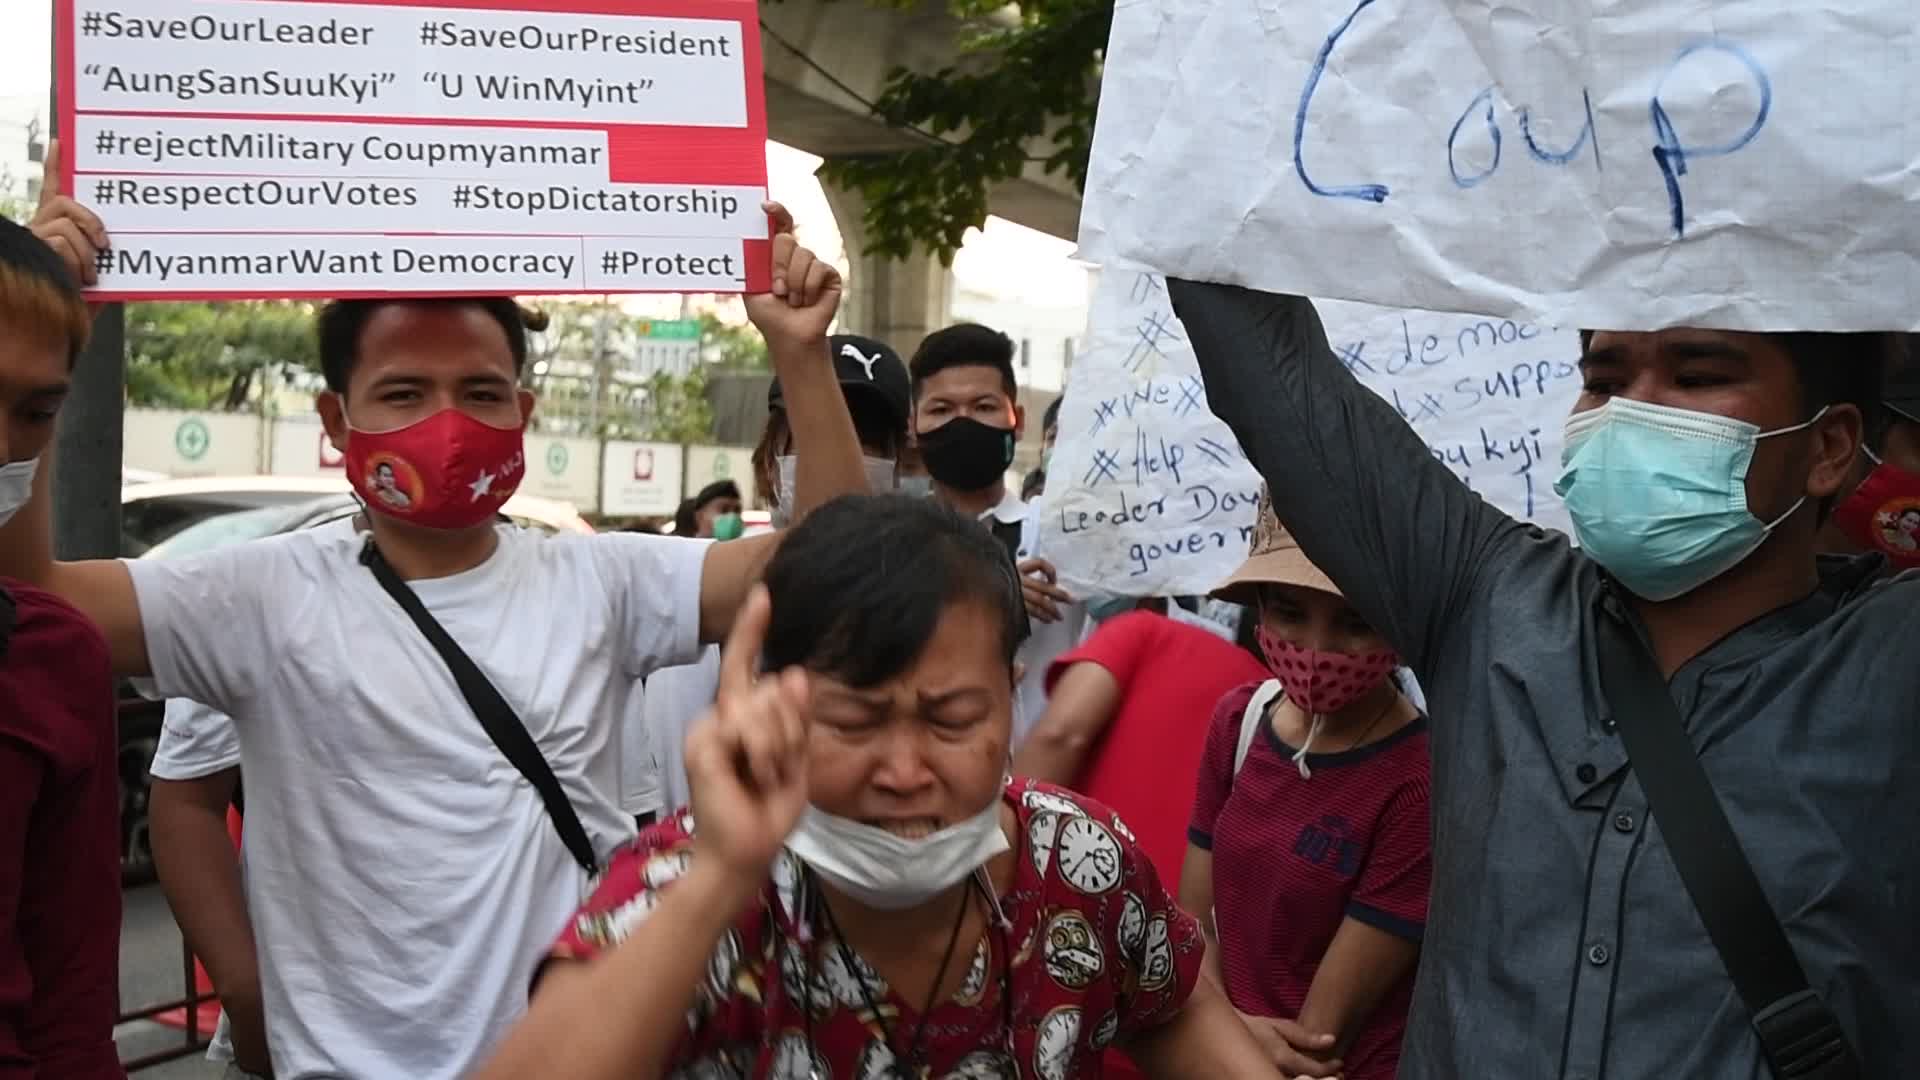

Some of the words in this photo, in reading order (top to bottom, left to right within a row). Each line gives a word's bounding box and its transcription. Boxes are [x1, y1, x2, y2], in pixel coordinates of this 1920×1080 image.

[82, 11, 374, 46] #SaveOurLeader
[420, 21, 731, 57] #SaveOurPresident
[83, 65, 396, 104] “AungSanSuuKyi”
[422, 72, 464, 99] “U
[475, 74, 653, 107] WinMyint”
[96, 131, 354, 166] #rejectMilitary
[363, 136, 601, 169] Coupmyanmar
[95, 180, 417, 211] #RespectOurVotes
[453, 184, 738, 219] #StopDictatorship
[96, 248, 383, 280] #MyanmarWant
[393, 249, 574, 279] Democracy
[1061, 490, 1167, 533] Leader
